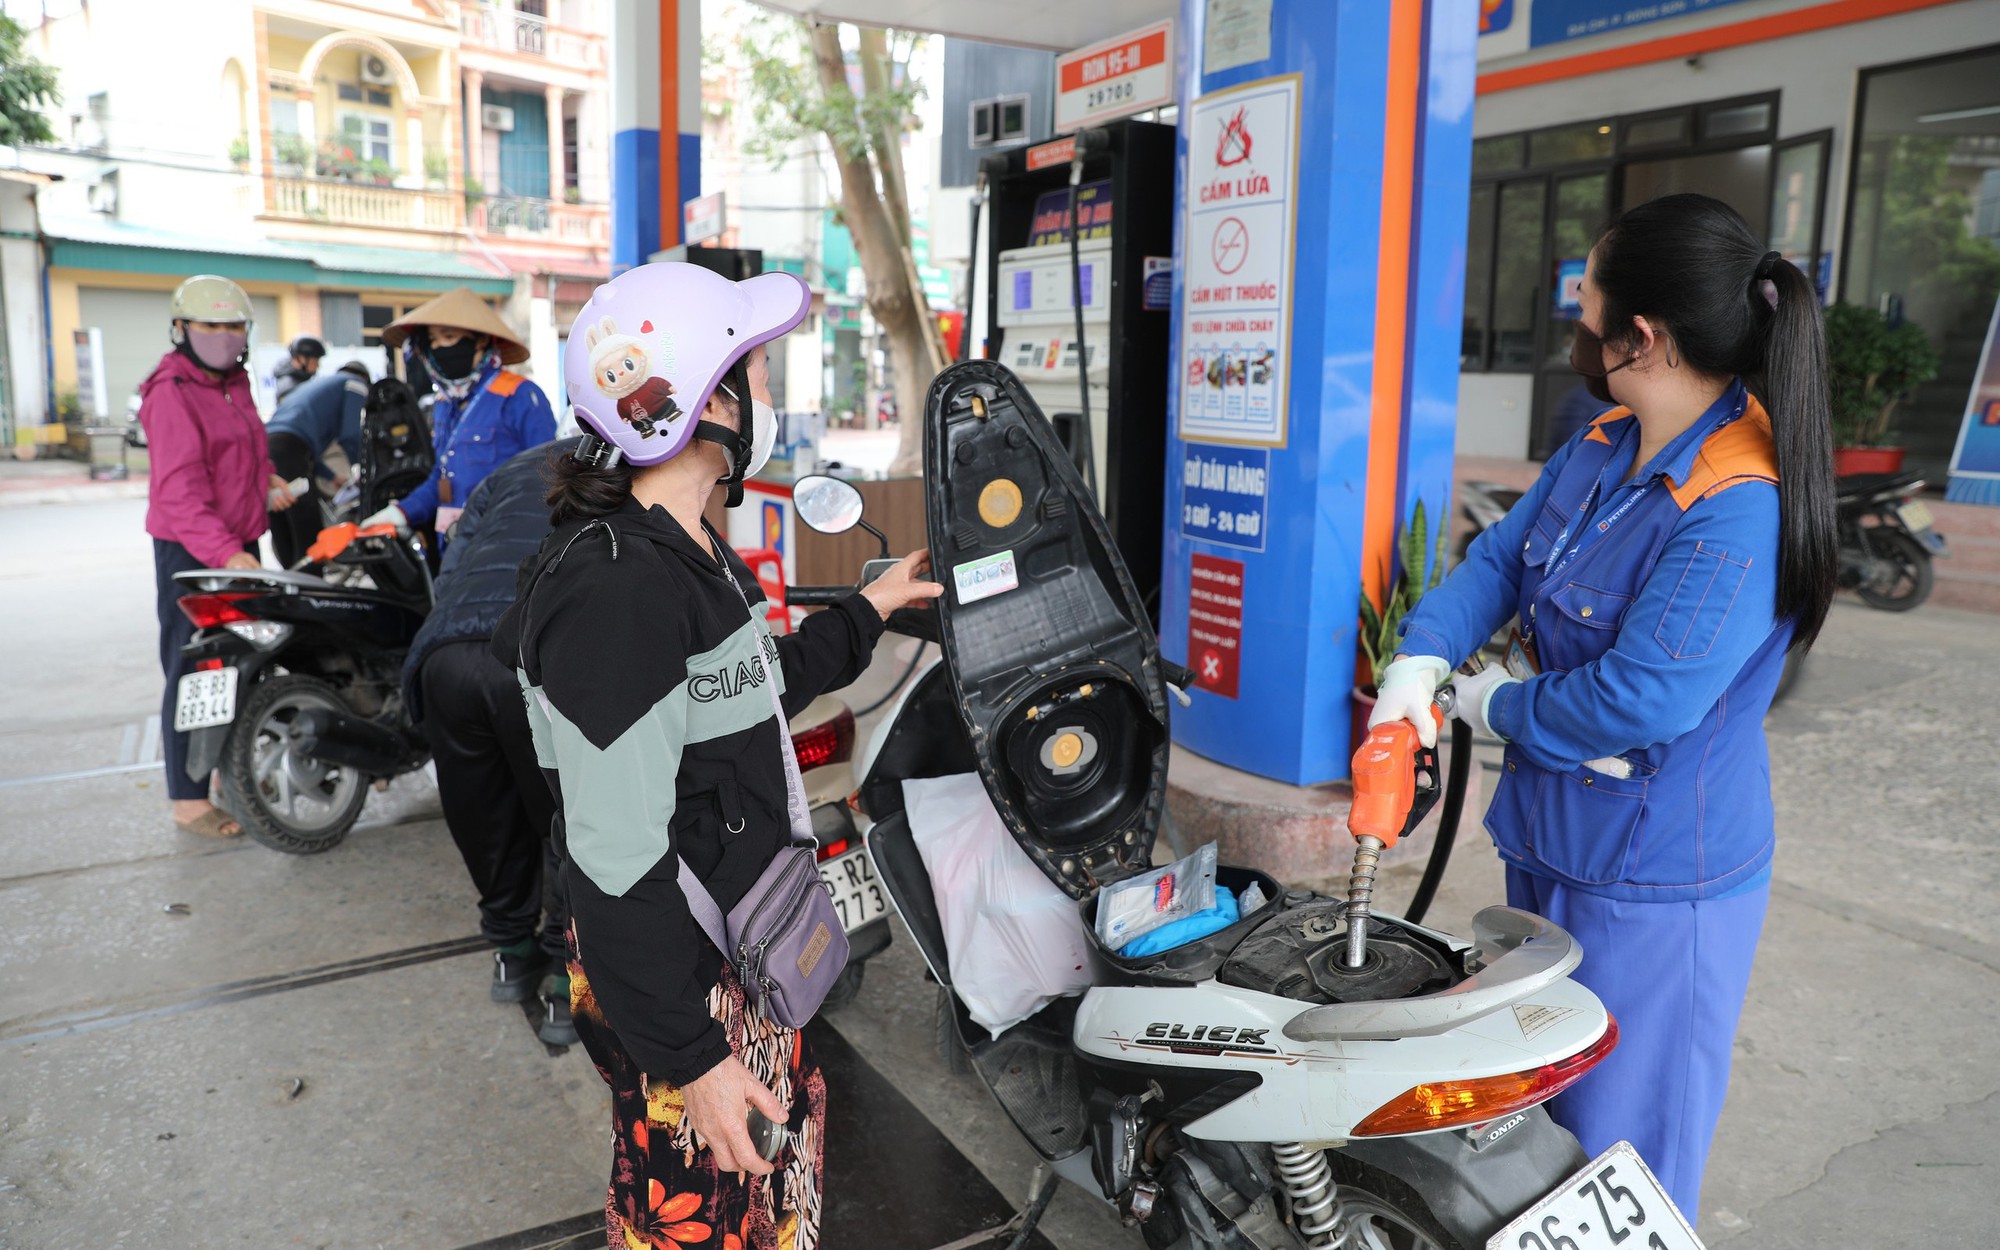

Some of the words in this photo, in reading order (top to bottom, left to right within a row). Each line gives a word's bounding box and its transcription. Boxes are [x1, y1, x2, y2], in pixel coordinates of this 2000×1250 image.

[1082, 56, 1107, 85] RON
[1200, 177, 1232, 204] CẤM
[1237, 169, 1270, 197] LỬA
[1236, 279, 1277, 301] THUỐC
[1201, 457, 1226, 492] BÁN
[1226, 460, 1265, 497] HÀNG
[1607, 487, 1647, 524] PETROLIMEX
[1217, 510, 1234, 533] 24
[1235, 510, 1261, 537] GIỜ
[1146, 1022, 1270, 1045] CLICK
[1483, 1113, 1526, 1143] ONDA
